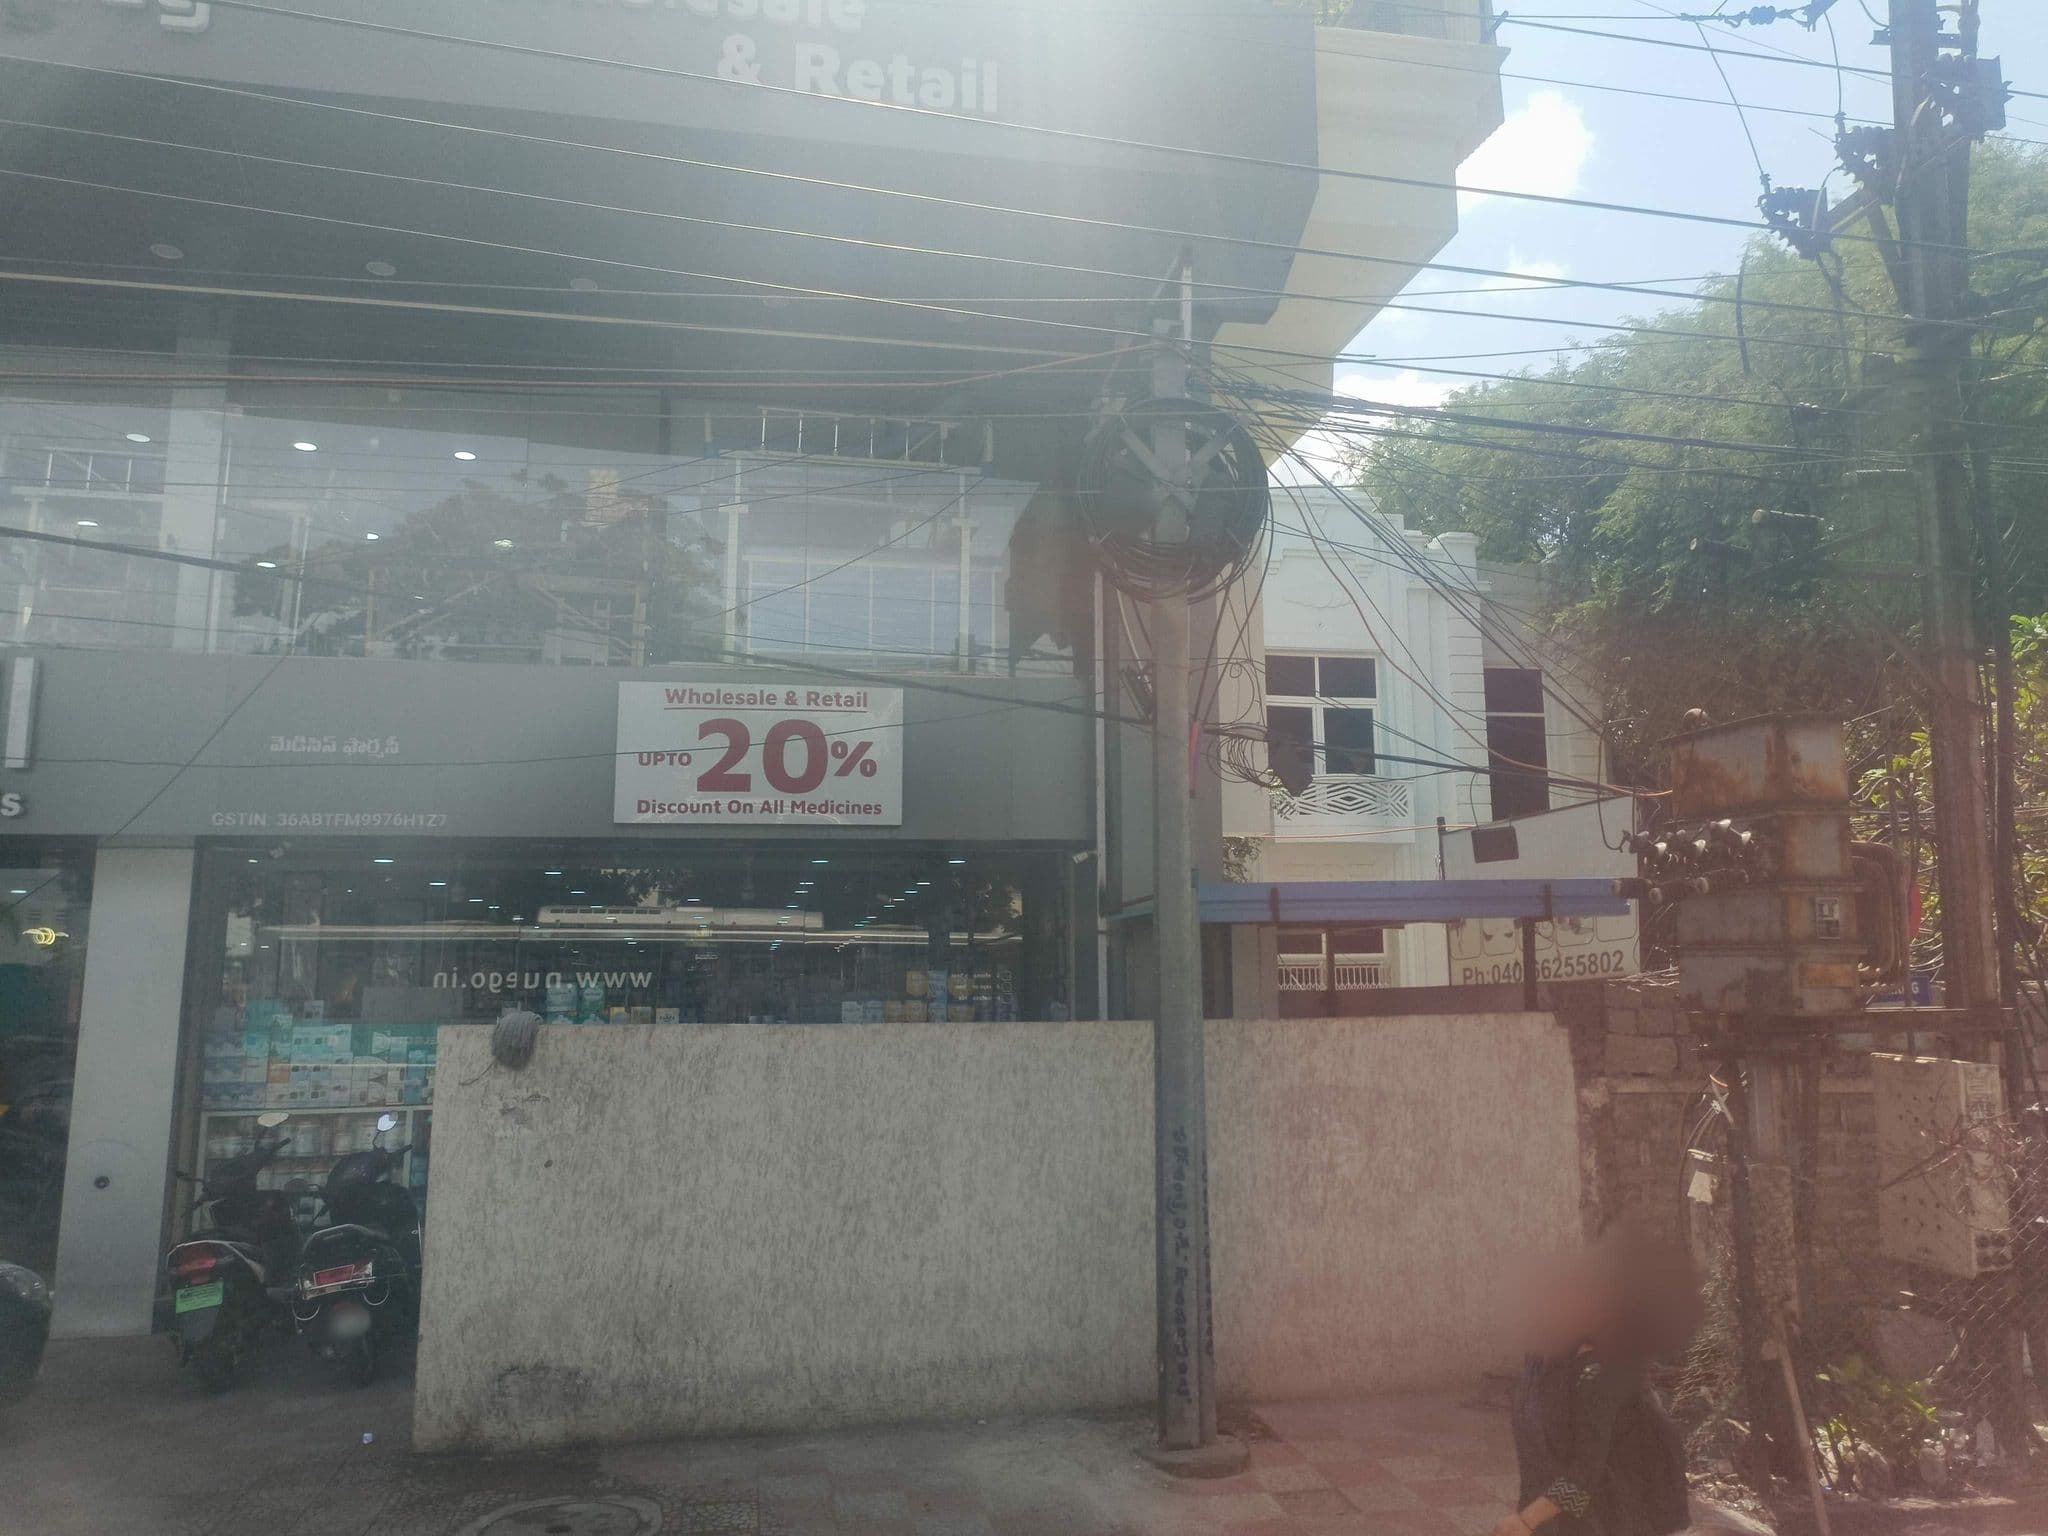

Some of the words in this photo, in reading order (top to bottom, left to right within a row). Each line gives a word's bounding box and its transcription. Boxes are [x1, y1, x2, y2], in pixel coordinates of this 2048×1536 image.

[718, 33, 761, 85] &
[794, 41, 999, 112] Retail
[665, 687, 777, 706] Wholesale
[783, 690, 799, 706] &
[806, 690, 868, 708] Retail
[638, 751, 692, 766] UPTO
[697, 717, 878, 794] 20%
[637, 799, 721, 815] Discount
[727, 799, 754, 815] On
[760, 799, 784, 814] All
[790, 799, 882, 815] Medicines
